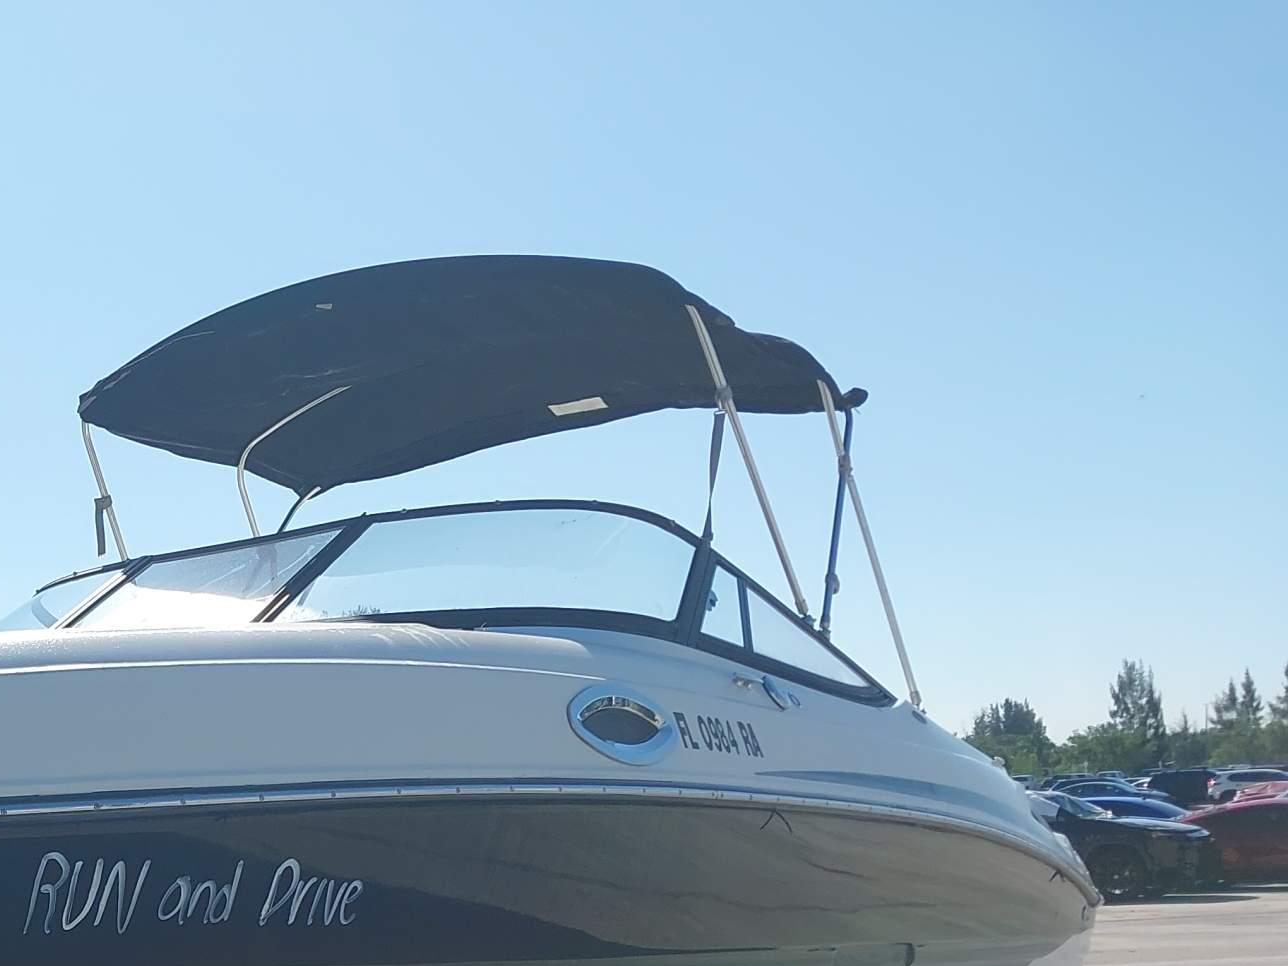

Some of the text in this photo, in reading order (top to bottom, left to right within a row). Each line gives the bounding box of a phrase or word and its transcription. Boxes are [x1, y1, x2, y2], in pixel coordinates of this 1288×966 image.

[673, 711, 764, 758] FL 0984 RA
[23, 851, 363, 934] RUN and Drive
